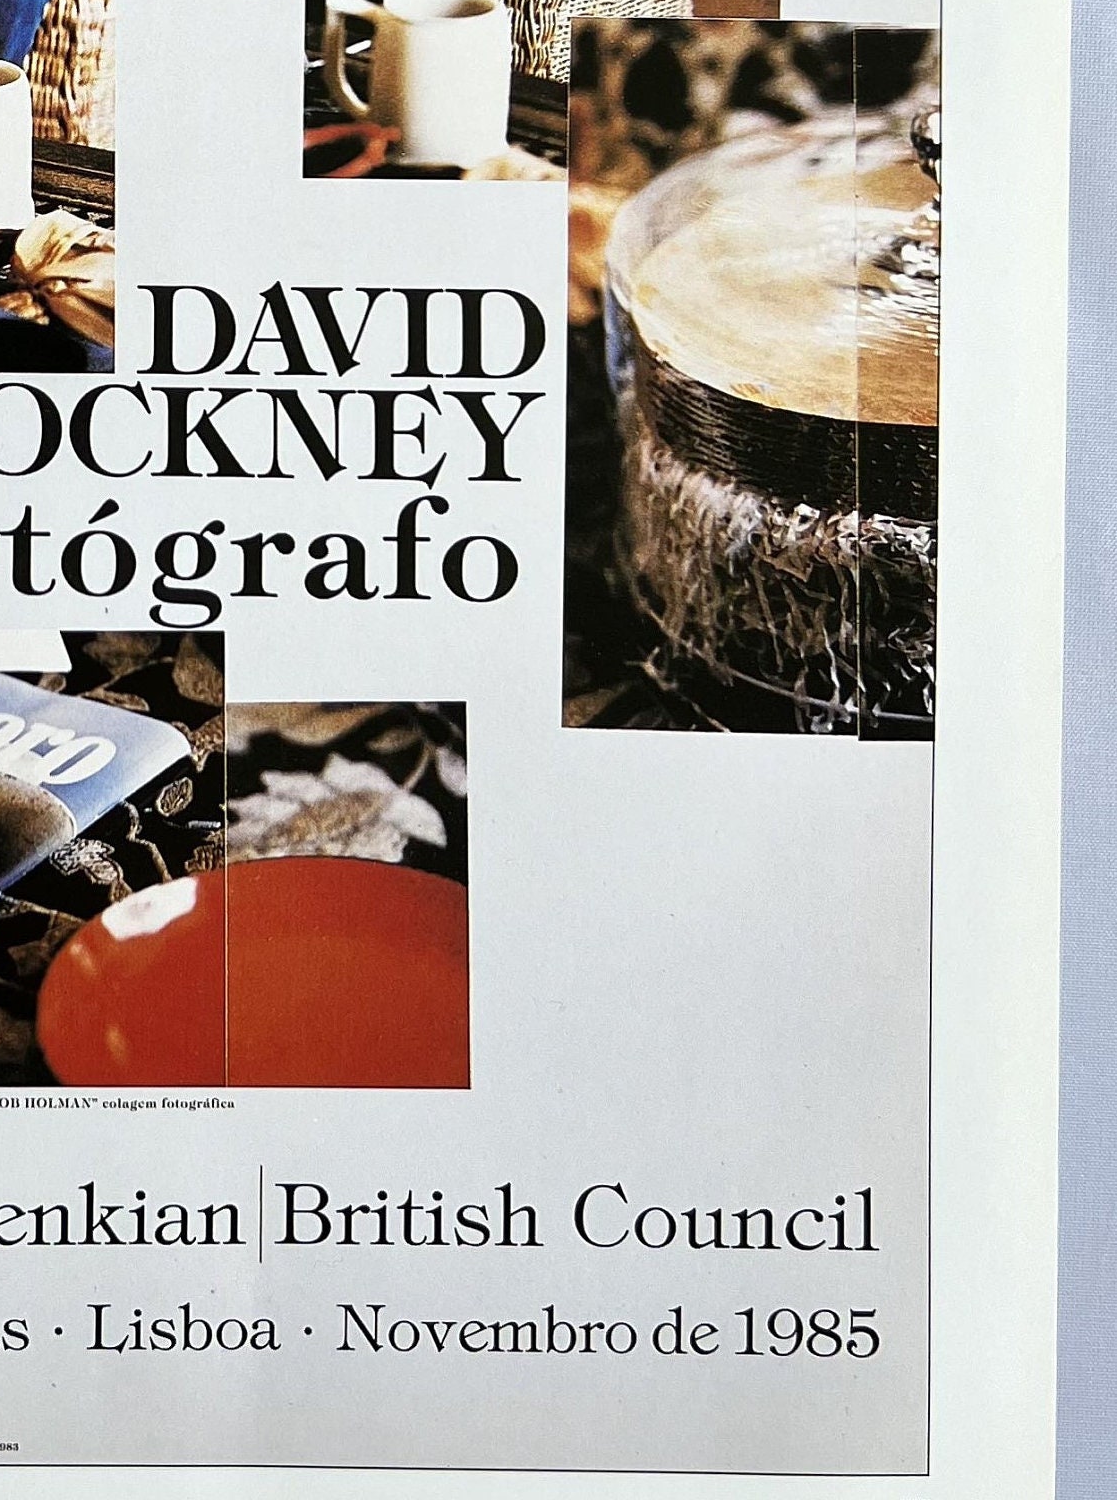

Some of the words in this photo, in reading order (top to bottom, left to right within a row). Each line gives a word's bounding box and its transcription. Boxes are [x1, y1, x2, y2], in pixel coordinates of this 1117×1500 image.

[137, 281, 545, 379] DAVID
[102, 1097, 157, 1112] colagem
[161, 1097, 235, 1111] fotográfica
[274, 1182, 544, 1247] British
[574, 1182, 880, 1251] Council
[86, 1303, 281, 1355] Lisboa
[336, 1304, 637, 1355] Novembro
[652, 1306, 720, 1356] de
[734, 1308, 880, 1359] 1985
